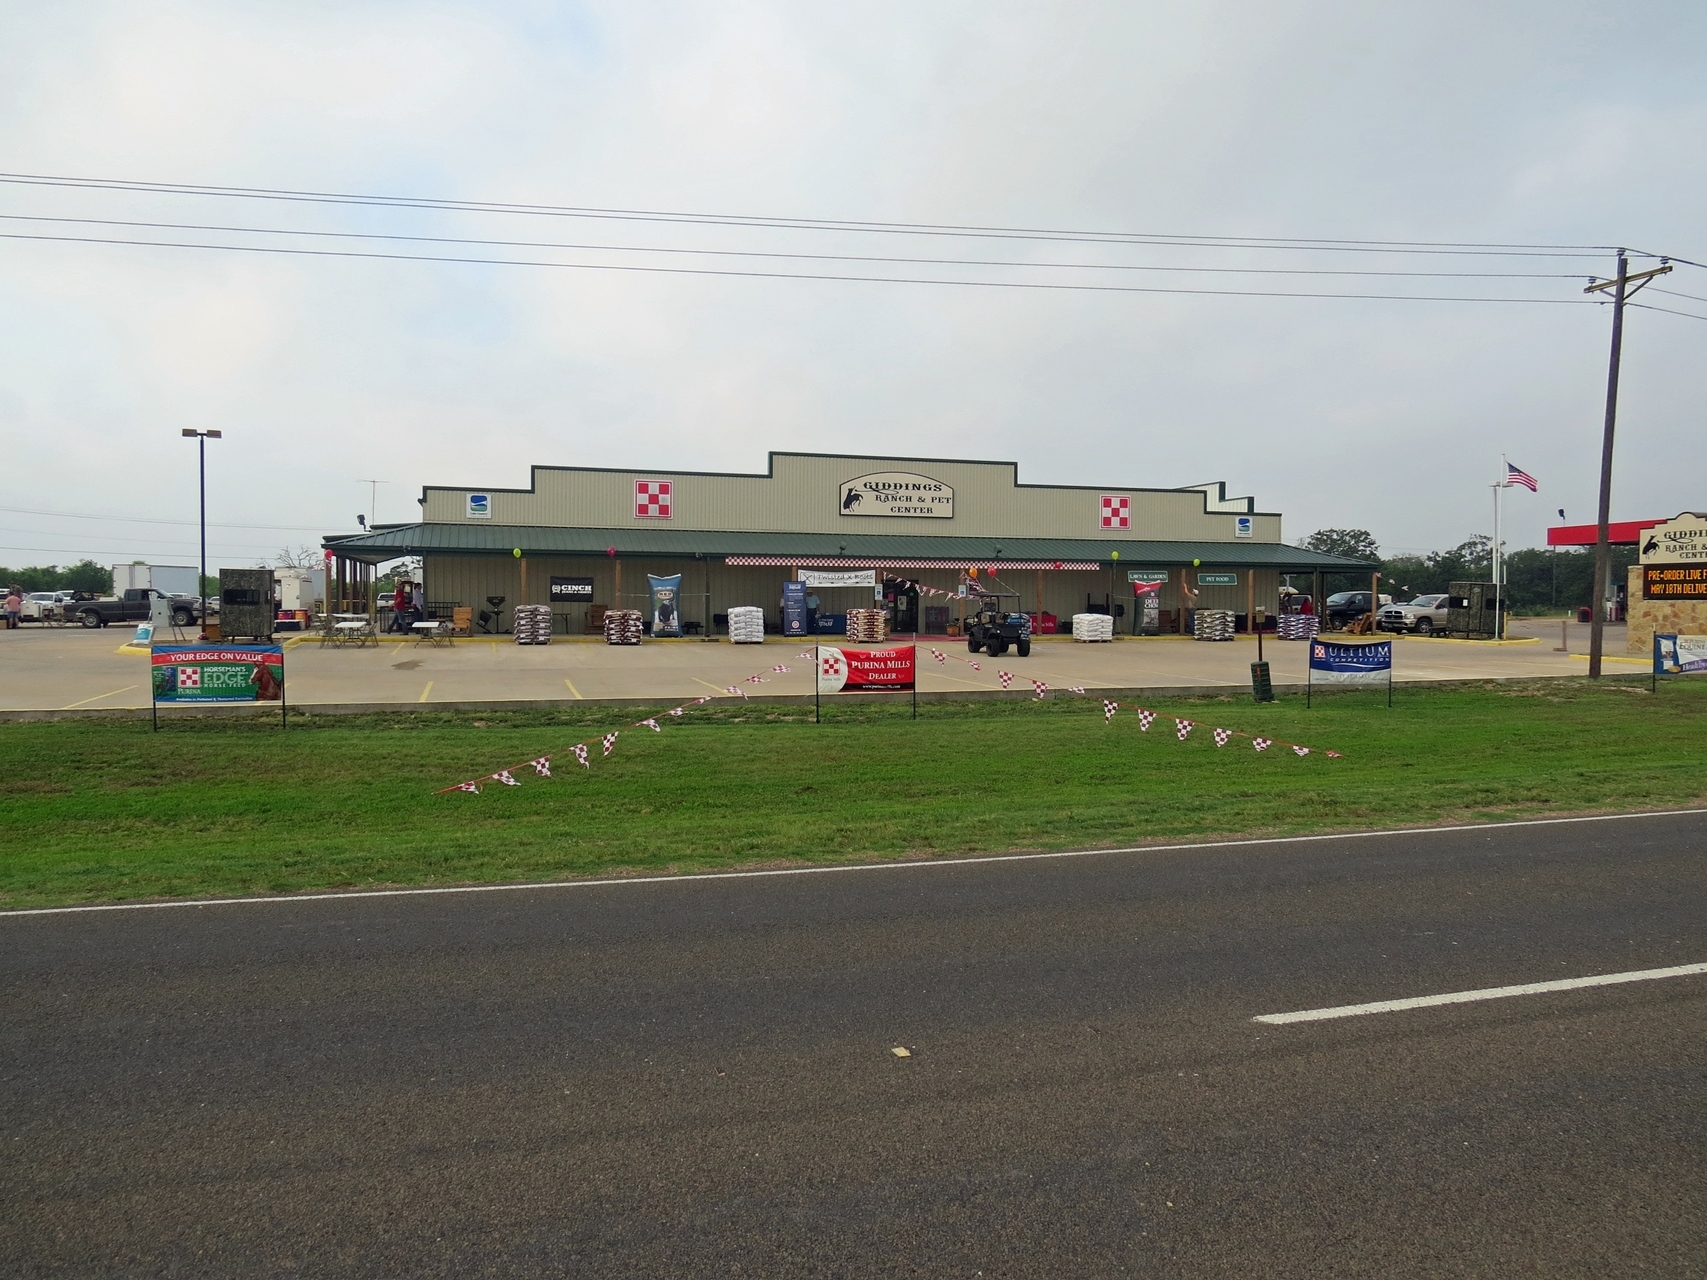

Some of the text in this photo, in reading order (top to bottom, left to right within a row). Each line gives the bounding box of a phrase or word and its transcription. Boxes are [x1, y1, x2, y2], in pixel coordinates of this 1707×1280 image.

[863, 481, 942, 491] GIDDINGS
[875, 494, 912, 503] RANCH
[890, 506, 933, 514] CENTER
[1664, 529, 1707, 540] GIDDI
[1665, 543, 1697, 553] RANCH
[1648, 569, 1685, 580] PRE-ORDER
[1686, 569, 1702, 580] LIVE
[1650, 583, 1664, 594] MAY
[1665, 583, 1682, 594] 18TH
[1329, 646, 1389, 657] ULTIUM
[170, 652, 263, 662] YOUR EDGE ON VALUE
[851, 660, 911, 669] PURINA MILLS
[204, 672, 246, 684] EDGE
[868, 672, 897, 680] DEALER
